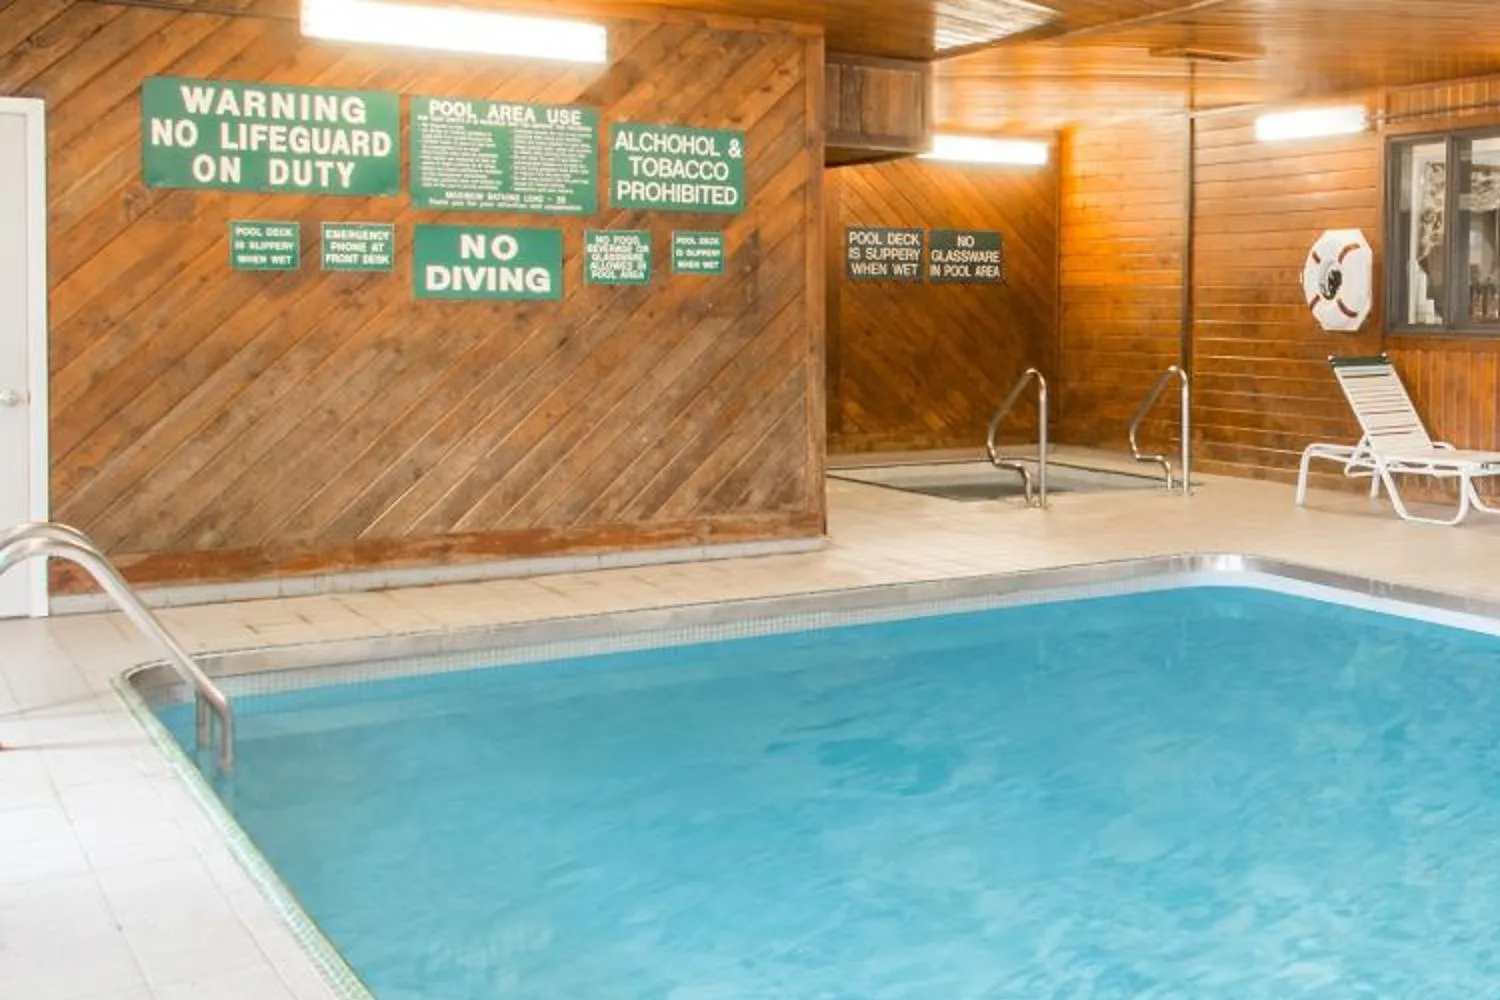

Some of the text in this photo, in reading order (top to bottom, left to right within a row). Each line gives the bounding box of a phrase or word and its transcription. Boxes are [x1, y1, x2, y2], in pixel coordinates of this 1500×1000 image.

[180, 85, 367, 125] WARNING
[428, 99, 583, 125] POOL AREA USE
[151, 117, 198, 148] NO
[220, 122, 392, 157] LIFEGUARD
[615, 130, 742, 158] ALCHOHOL &
[192, 154, 355, 188] ON DUTY
[628, 156, 729, 181] TOBACCO
[616, 180, 739, 206] PROHIBITED
[235, 226, 263, 237] POOL
[325, 229, 390, 252] EMERGENCY PHONE AT
[849, 231, 921, 246] POOL DECK
[957, 235, 975, 248] NO
[459, 233, 519, 260] NO
[848, 247, 921, 261] IS SLIPPERY
[931, 250, 1000, 263] GLASSWARE
[270, 255, 292, 265] WET
[325, 253, 359, 265] FRONT
[851, 263, 918, 276] WHEN WET
[425, 265, 551, 293] DIVING
[929, 264, 1000, 278] IN POOL AREA
